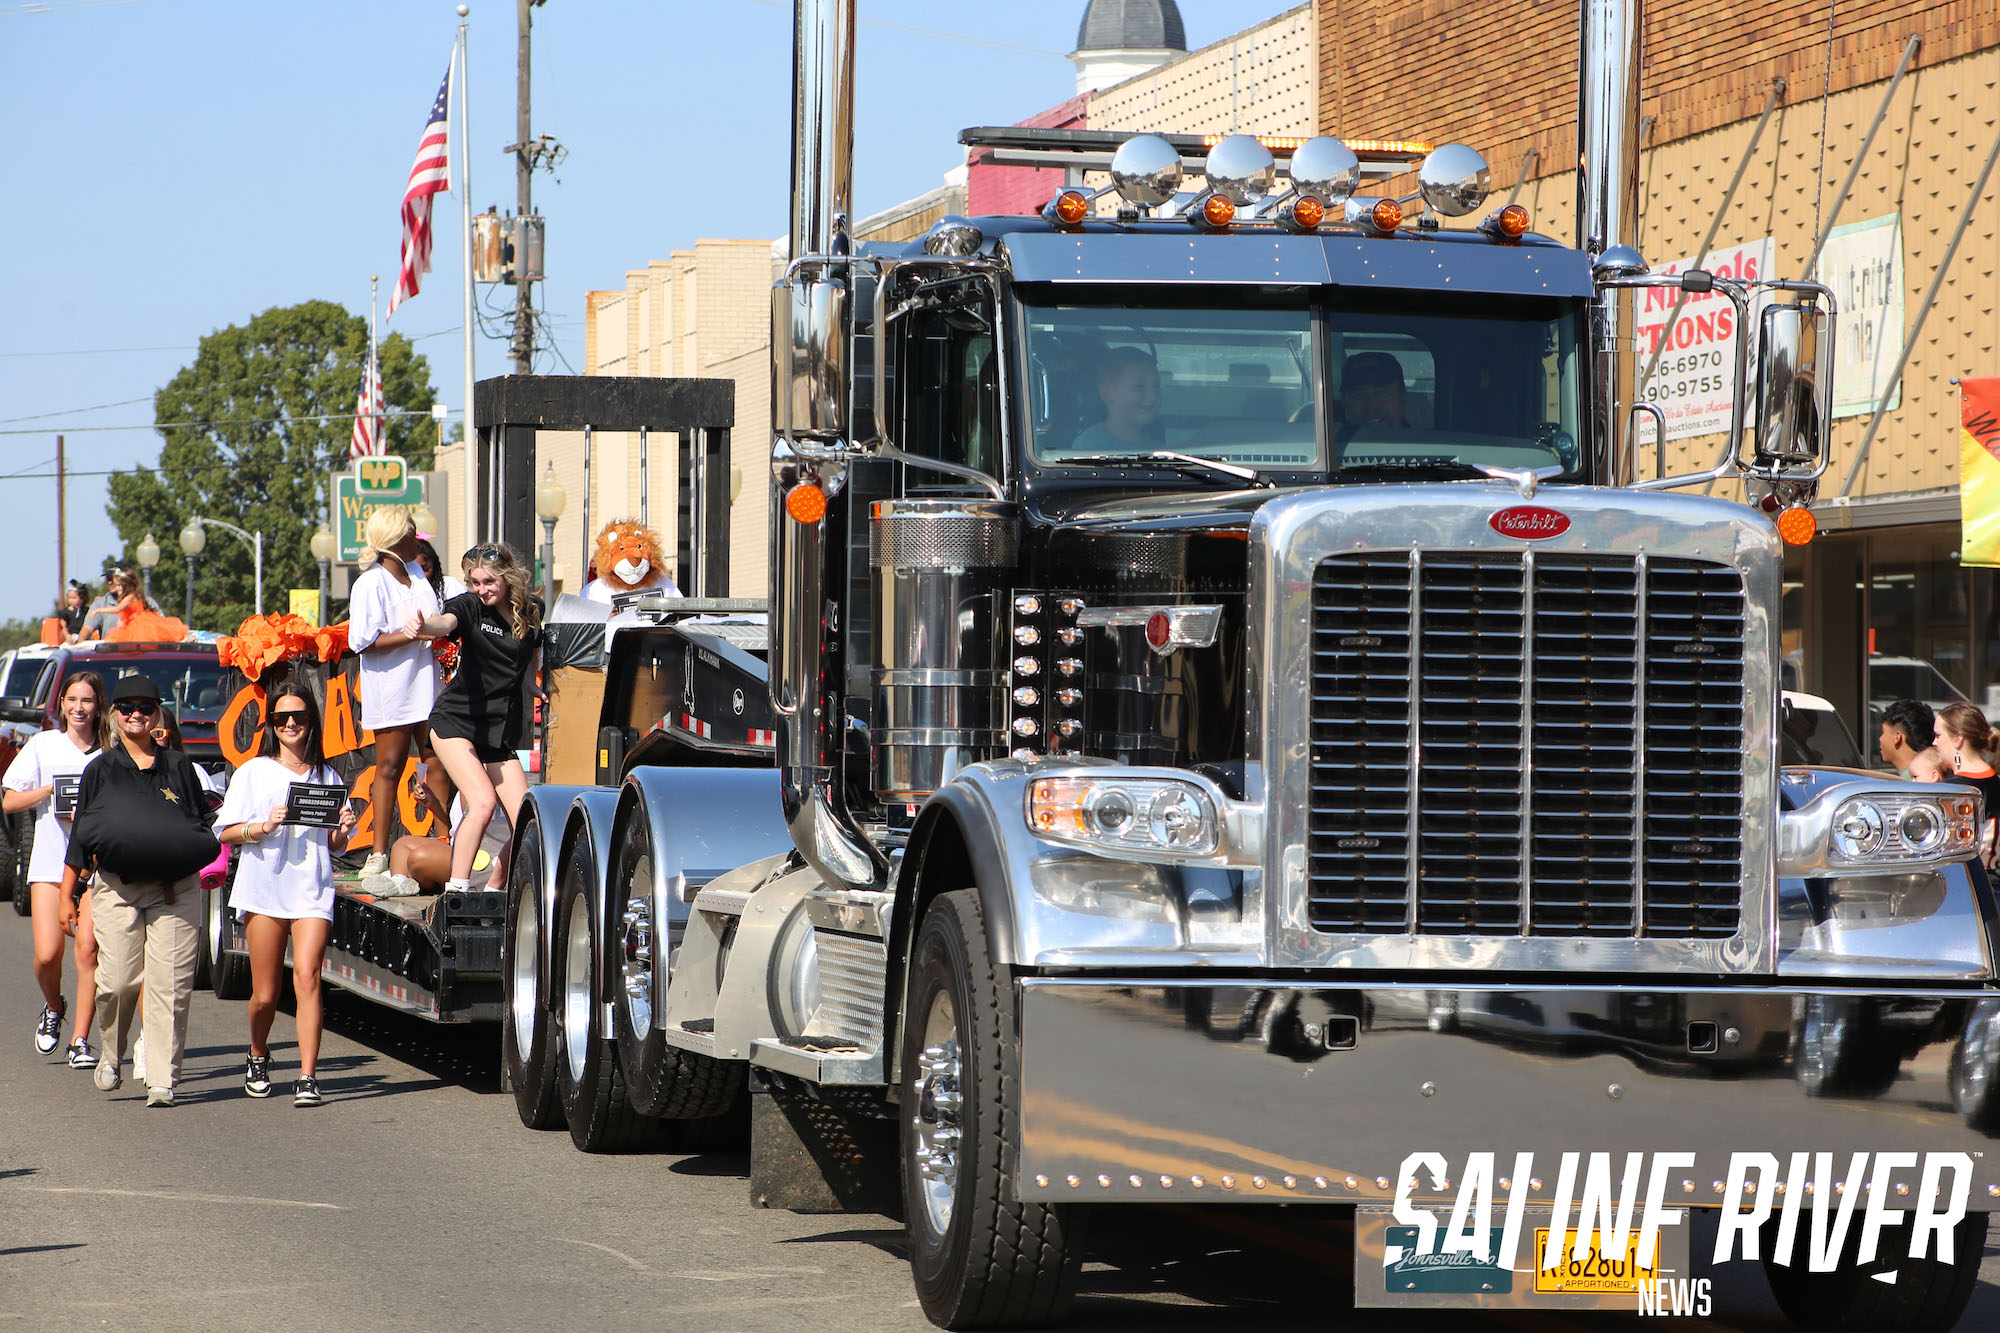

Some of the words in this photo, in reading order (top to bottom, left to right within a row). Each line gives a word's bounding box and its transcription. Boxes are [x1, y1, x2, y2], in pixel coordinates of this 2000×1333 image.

[1498, 511, 1564, 530] Peterbilt
[481, 623, 503, 636] POLICE
[1565, 1280, 1629, 1288] APPORTIONED
